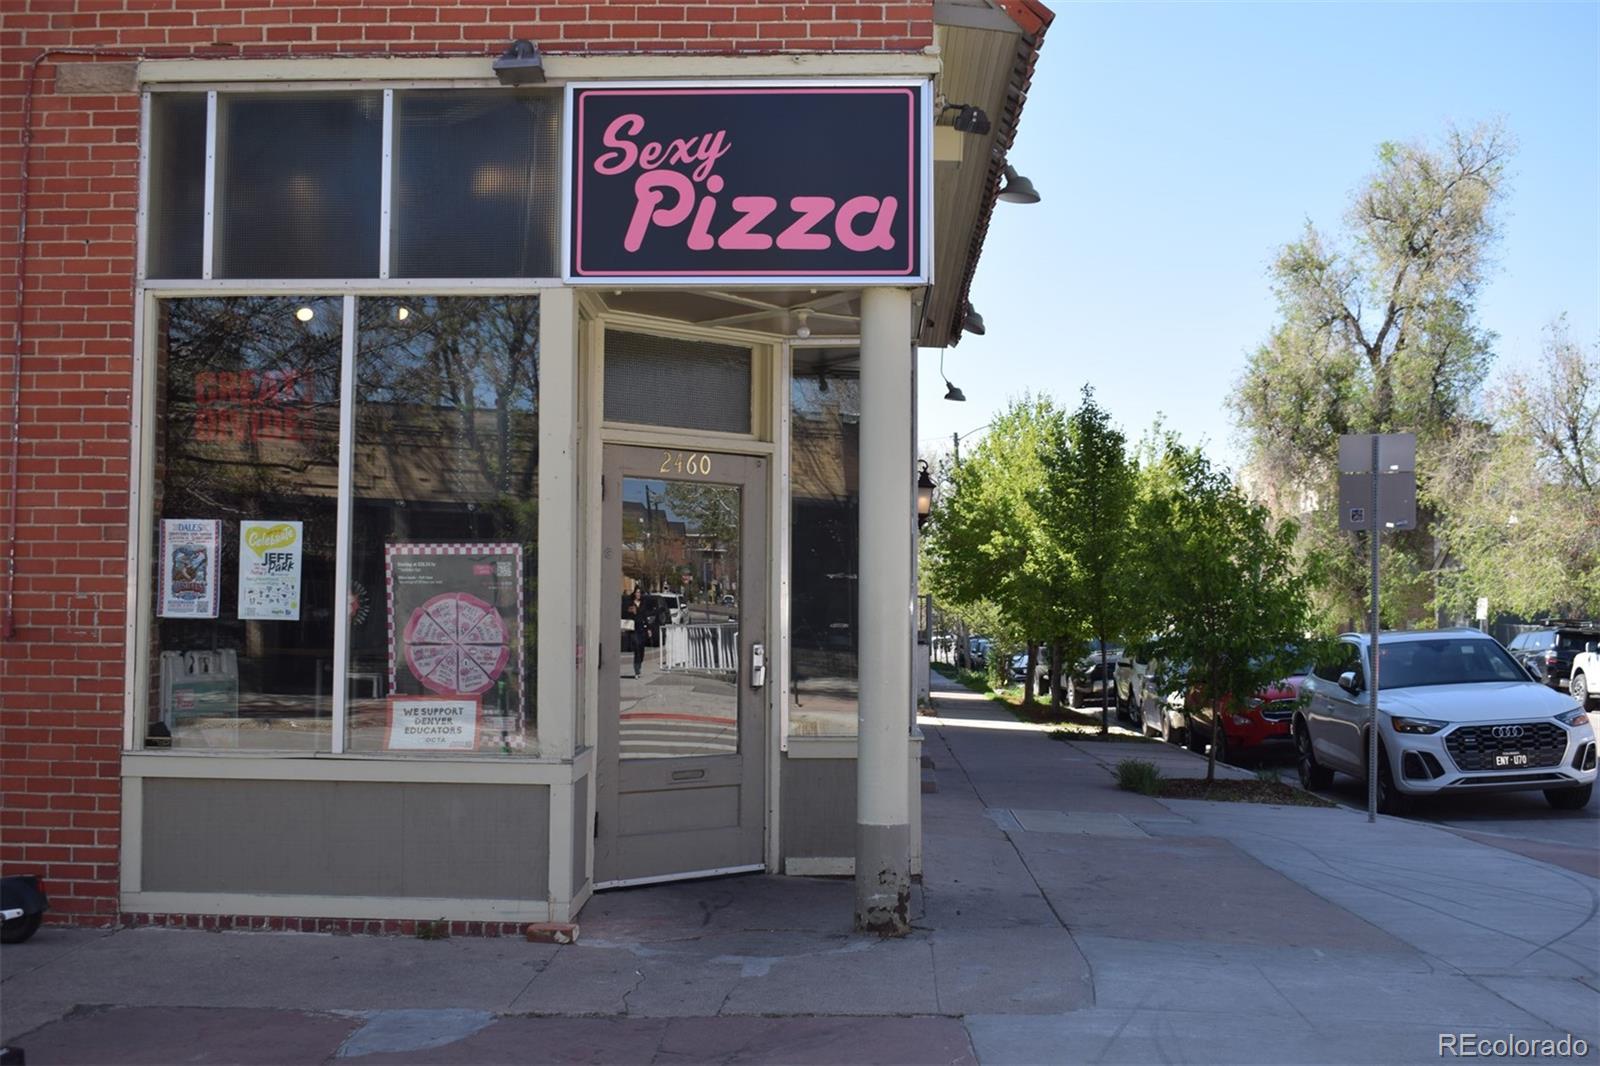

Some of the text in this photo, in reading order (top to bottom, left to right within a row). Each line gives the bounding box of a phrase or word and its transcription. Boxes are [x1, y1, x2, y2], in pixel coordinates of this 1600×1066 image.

[593, 113, 732, 182] Sexy
[624, 169, 898, 252] Pizza
[660, 449, 711, 475] 2460
[261, 552, 293, 566] JEFF
[403, 707, 465, 716] WE SUPPORT
[414, 717, 454, 725] DENVER
[404, 727, 463, 735] EDUCATORS
